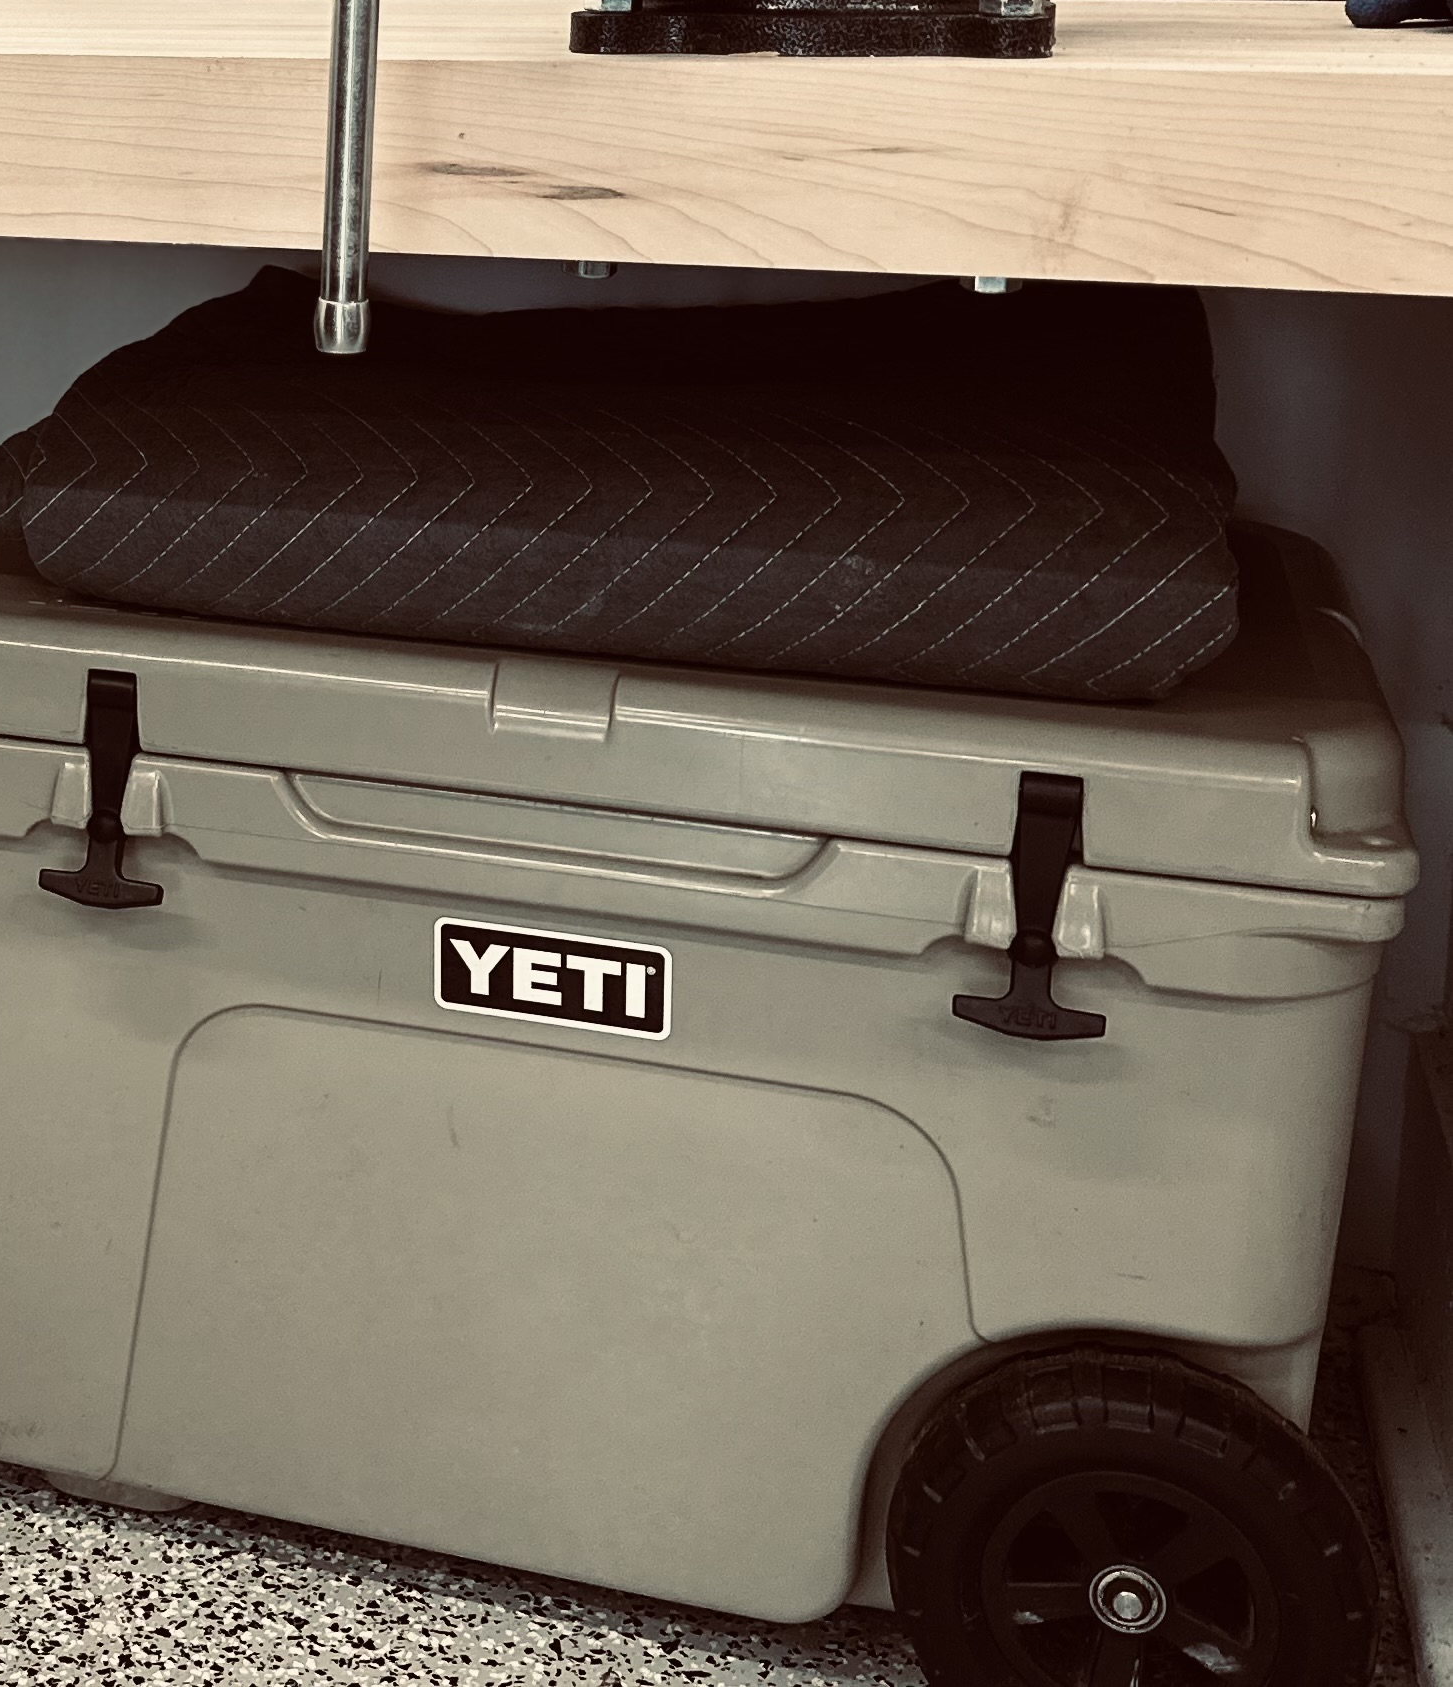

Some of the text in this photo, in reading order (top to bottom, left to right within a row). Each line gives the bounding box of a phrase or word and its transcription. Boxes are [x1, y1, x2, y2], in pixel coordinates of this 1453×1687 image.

[74, 877, 121, 899] YETI
[449, 938, 646, 1019] YETI
[998, 1004, 1058, 1030] YETI
